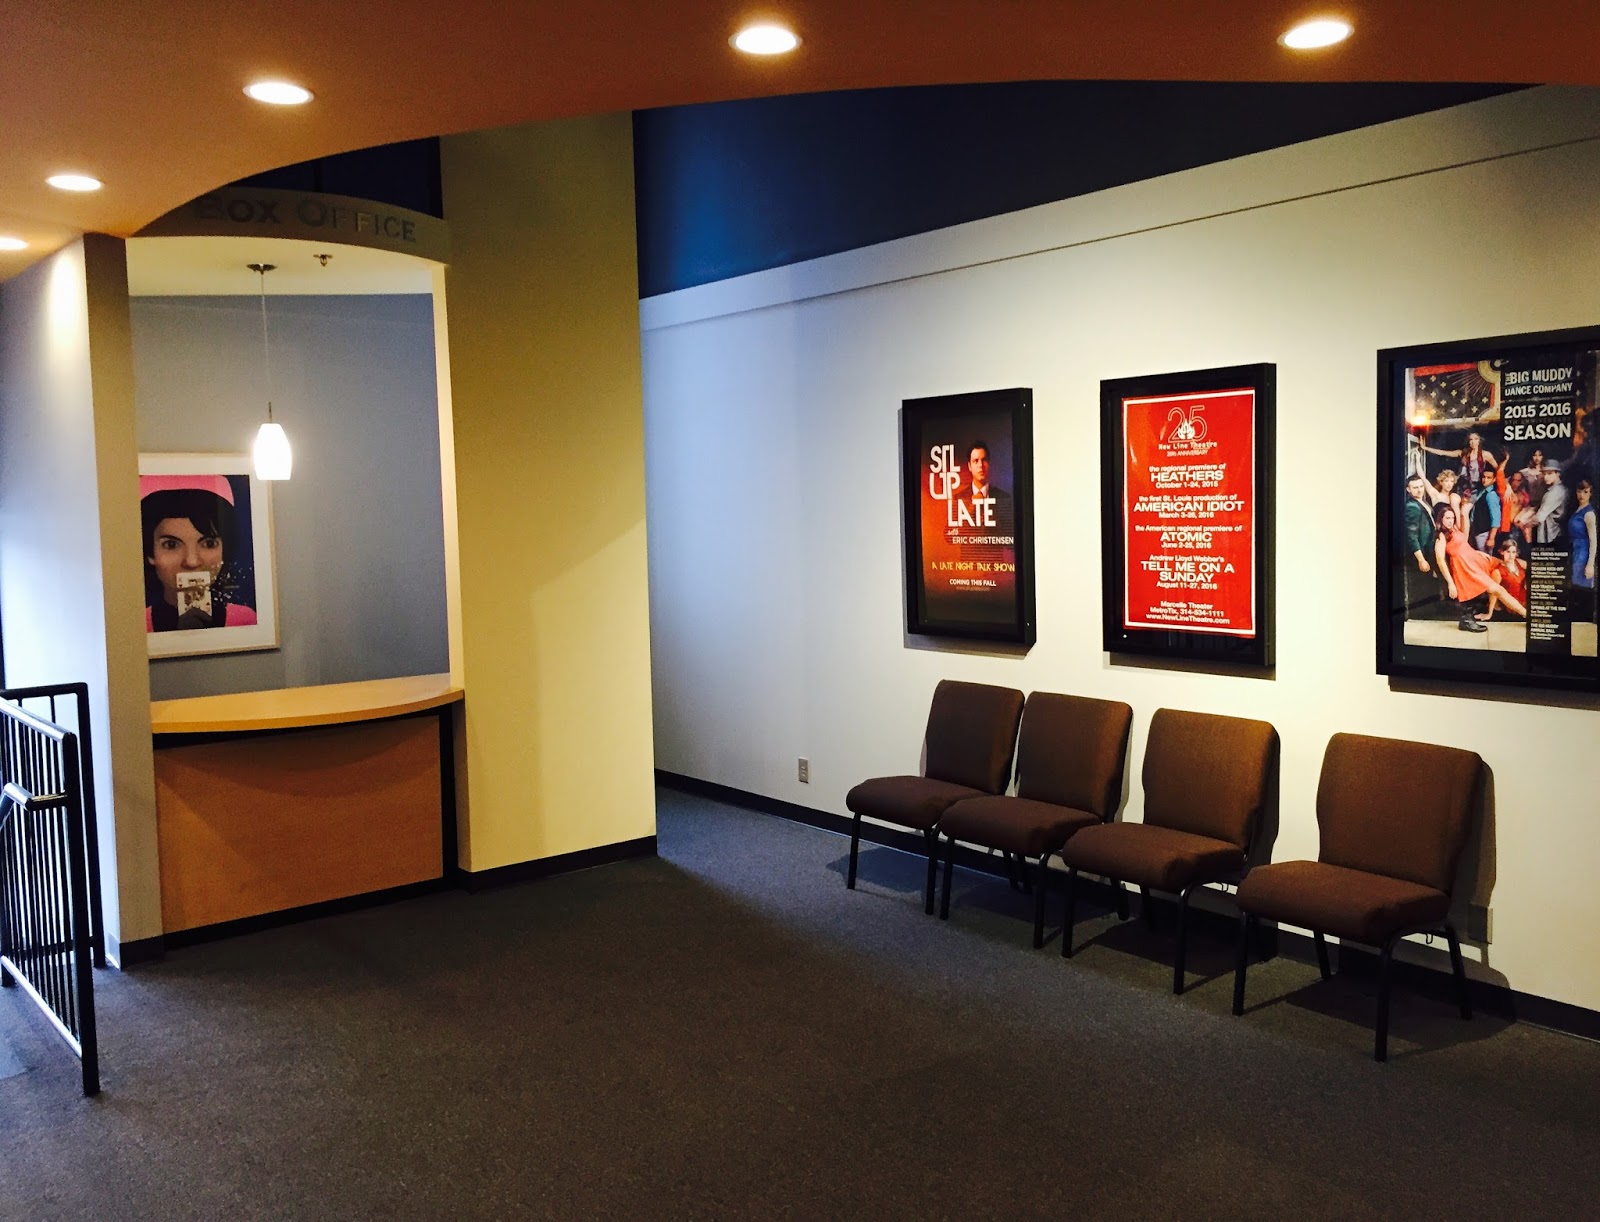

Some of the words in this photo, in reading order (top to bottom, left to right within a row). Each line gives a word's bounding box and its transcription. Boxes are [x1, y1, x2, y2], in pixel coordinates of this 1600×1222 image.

[297, 199, 417, 243] OFFICE
[1510, 371, 1529, 385] BIG
[1532, 367, 1572, 382] MUDDY
[1505, 385, 1532, 396] DANCE
[1533, 383, 1572, 394] COMPANY
[1504, 405, 1536, 419] 2015
[1539, 402, 1571, 417] 2016
[1168, 405, 1207, 443] 25
[1504, 423, 1571, 441] SEASON
[1161, 465, 1186, 473] regional
[1188, 464, 1217, 472] premiere
[1150, 470, 1224, 482] HEATHERS
[929, 472, 961, 500] UP
[1193, 494, 1228, 502] production
[948, 498, 996, 527] LATE
[1134, 501, 1203, 512] AMERICAN
[1207, 501, 1245, 511] IDIOT
[952, 536, 968, 544] ERIC
[969, 536, 1014, 544] CHRISTENSEN
[1160, 532, 1212, 542] ATOMIC
[940, 562, 953, 570] LATE
[956, 562, 974, 571] NIGHT
[977, 562, 991, 571] TALK
[994, 563, 1015, 572] SHOW
[1141, 561, 1172, 571] TELL
[1176, 562, 1195, 572] ME
[1199, 562, 1220, 573] ON
[1224, 563, 1234, 573] A
[1160, 572, 1214, 582] SUNDAY
[1157, 581, 1179, 589] August
[1146, 614, 1230, 624] www.NewLineTheatre.com
